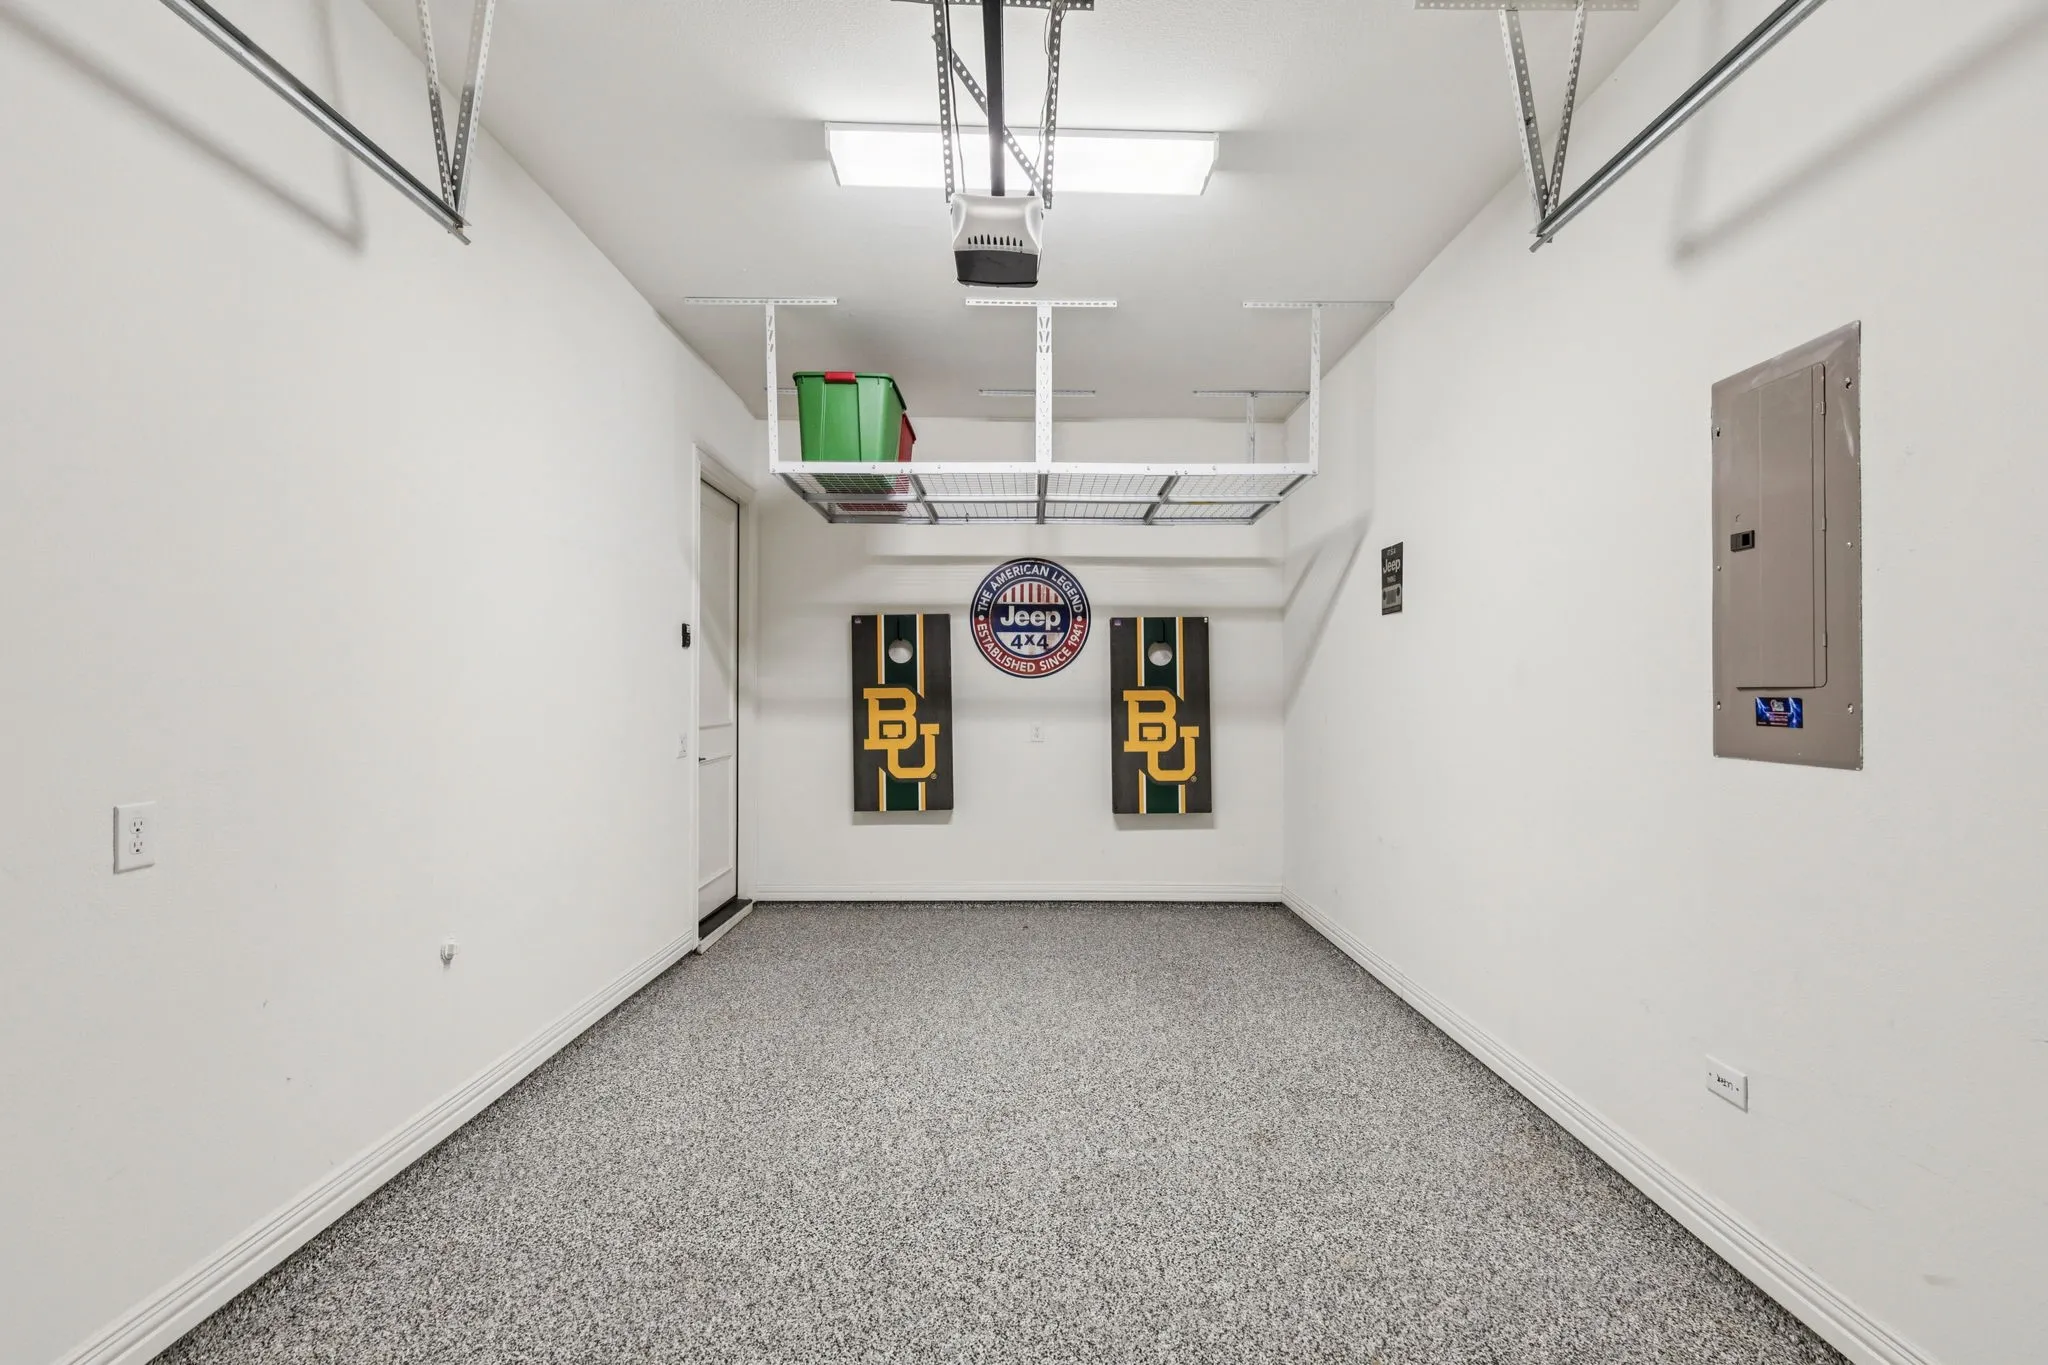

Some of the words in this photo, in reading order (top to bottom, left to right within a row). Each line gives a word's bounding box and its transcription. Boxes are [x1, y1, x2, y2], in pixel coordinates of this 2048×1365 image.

[977, 591, 993, 612] THE
[990, 564, 1050, 591] AMERICAN
[1051, 571, 1084, 613] LEGEND
[1383, 558, 1401, 573] Jeep
[1000, 605, 1061, 631] Jeep
[977, 623, 1036, 673] ESTABLISHED
[1039, 647, 1072, 671] SINCE
[1068, 624, 1084, 646] 1941
[863, 688, 940, 779] BU
[1122, 690, 1200, 782] BU
